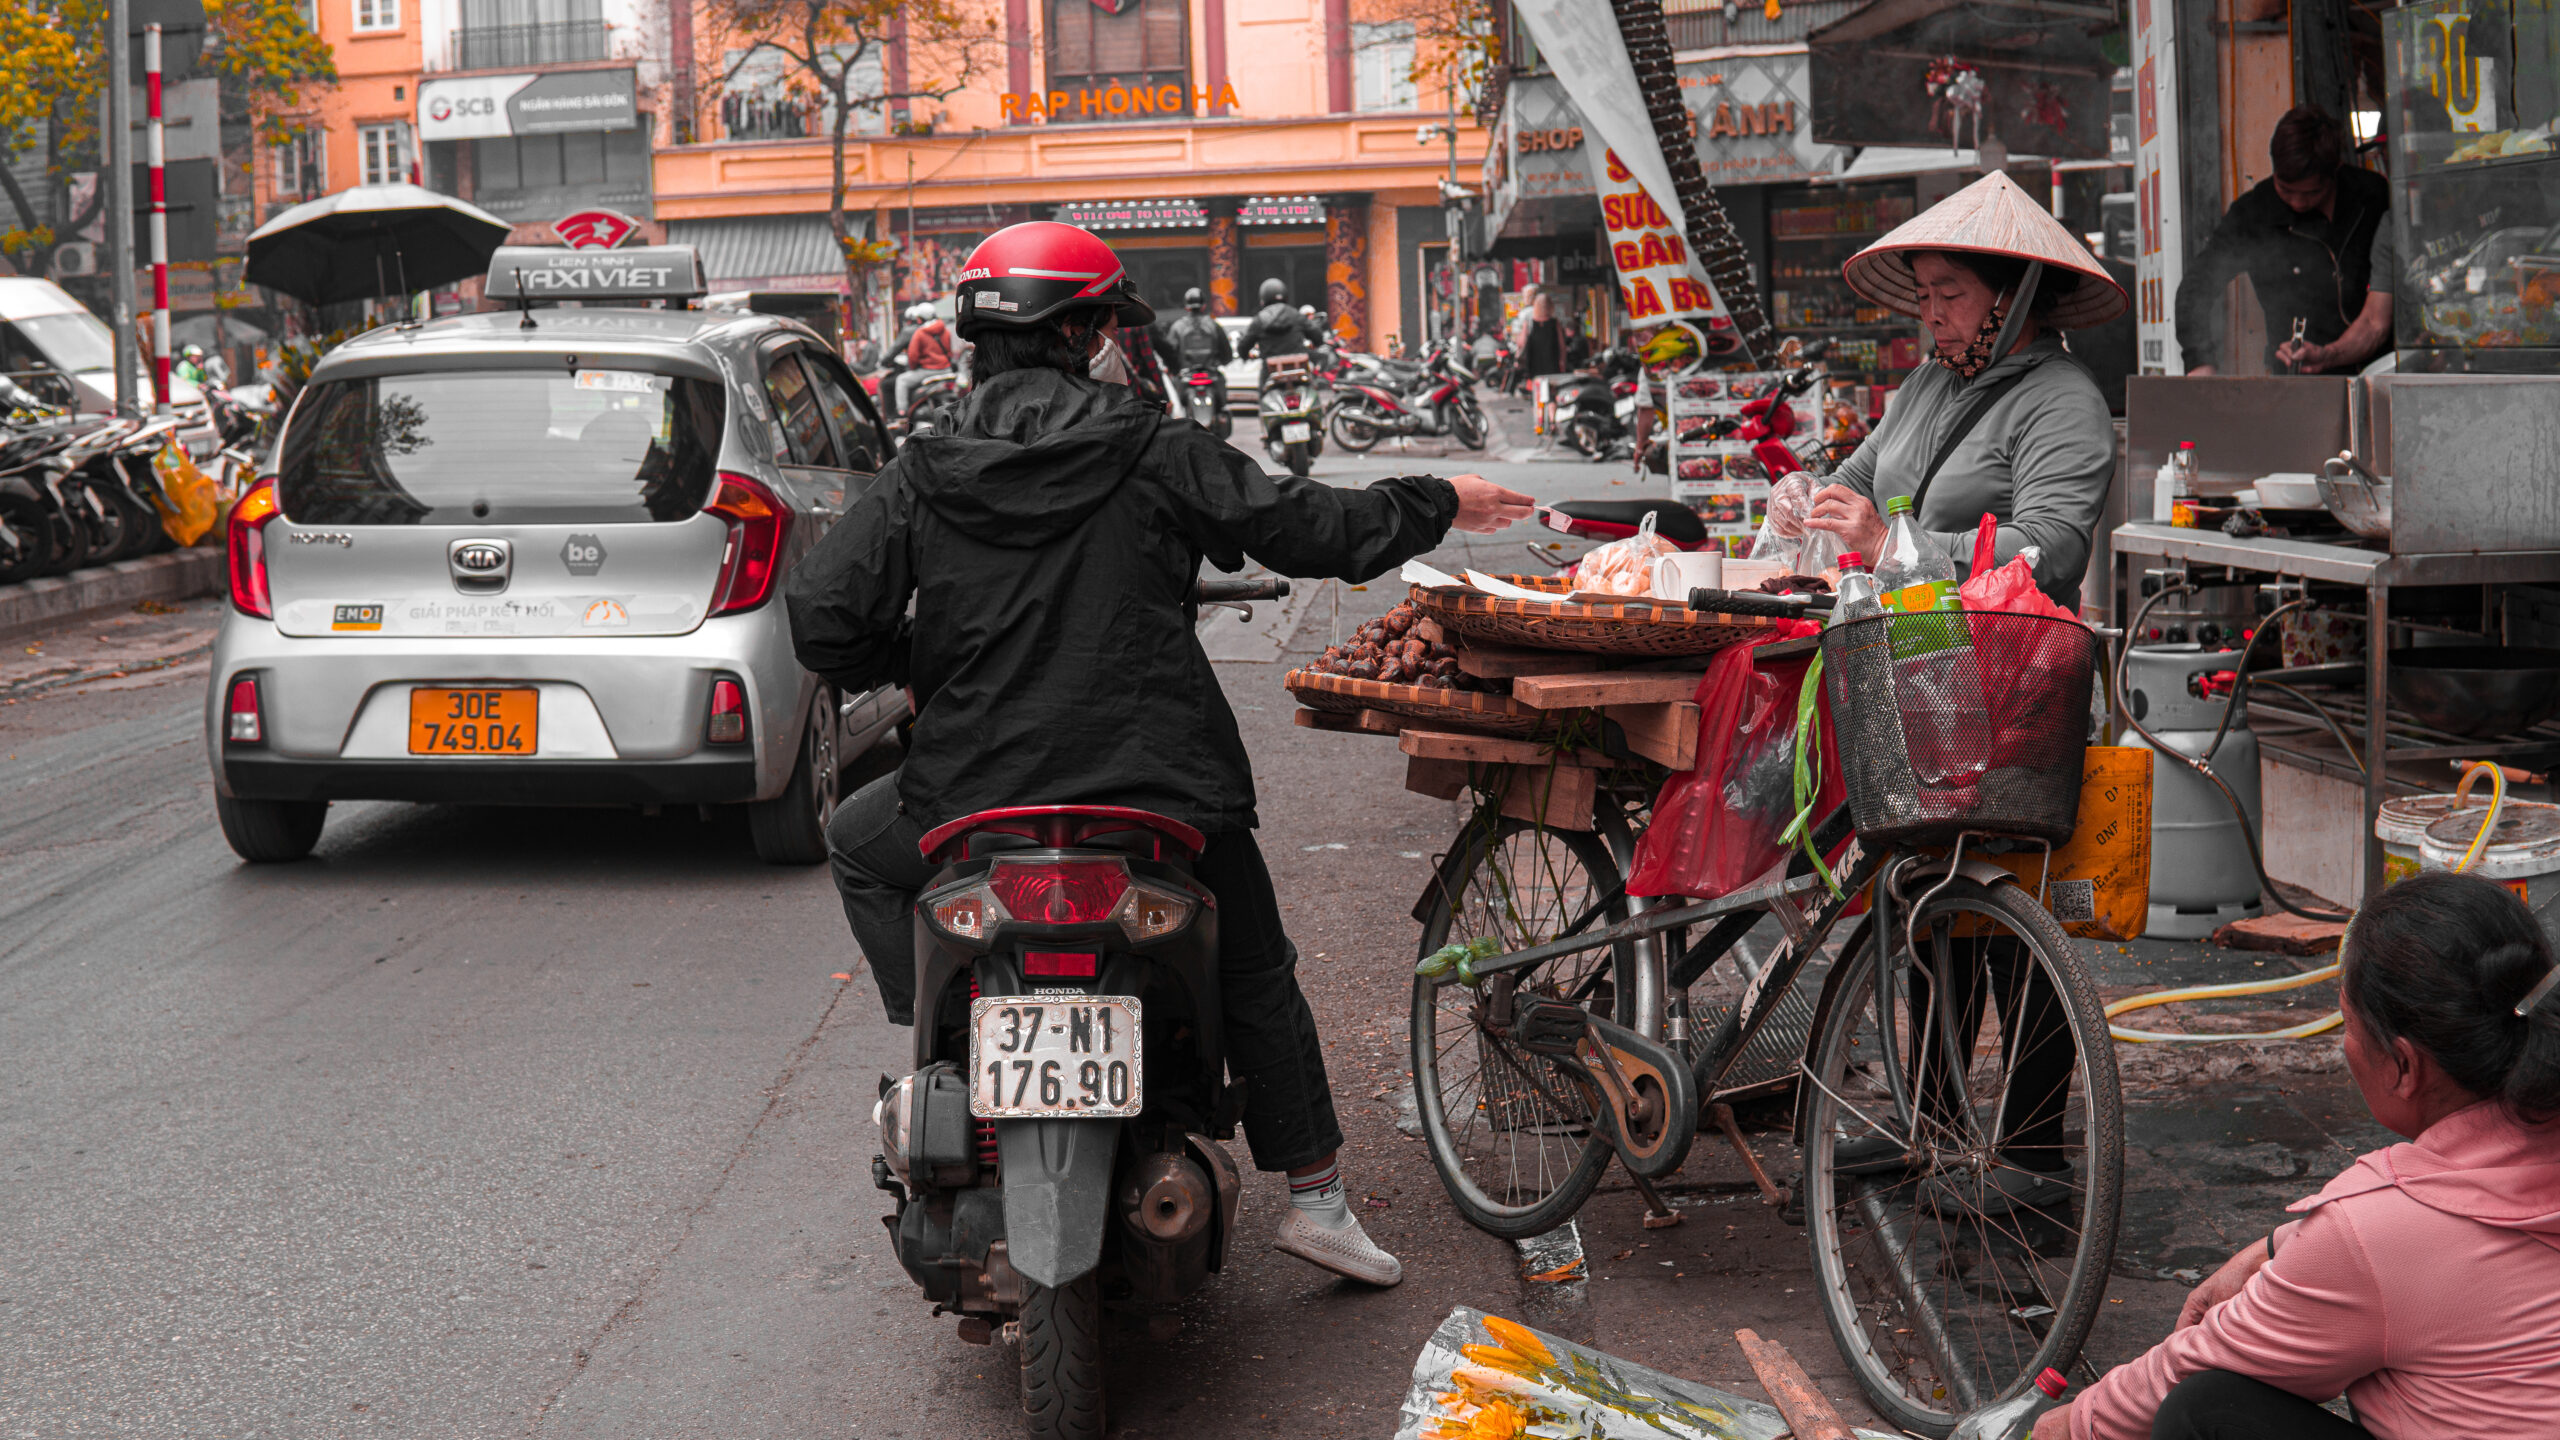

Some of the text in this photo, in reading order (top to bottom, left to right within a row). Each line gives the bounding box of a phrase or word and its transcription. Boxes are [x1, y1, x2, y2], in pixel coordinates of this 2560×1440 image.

[456, 98, 494, 116] SCB
[1000, 90, 1070, 124] RẠP
[1080, 77, 1182, 115] HỒNG
[1516, 127, 1584, 153] SHOP
[509, 267, 589, 289] TAXI
[959, 267, 991, 282] ONDA
[289, 532, 353, 548] morning
[461, 550, 497, 567] KIA
[568, 543, 599, 562] be
[335, 607, 381, 621] EMDI
[446, 603, 487, 618] PHÁP
[447, 691, 502, 719] 30E
[424, 723, 523, 750] 749.04
[1034, 987, 1086, 995] HONDA
[1000, 1006, 1112, 1053] 37-N1
[987, 1060, 1128, 1108] 176.90
[1319, 1183, 1343, 1199] FIL
